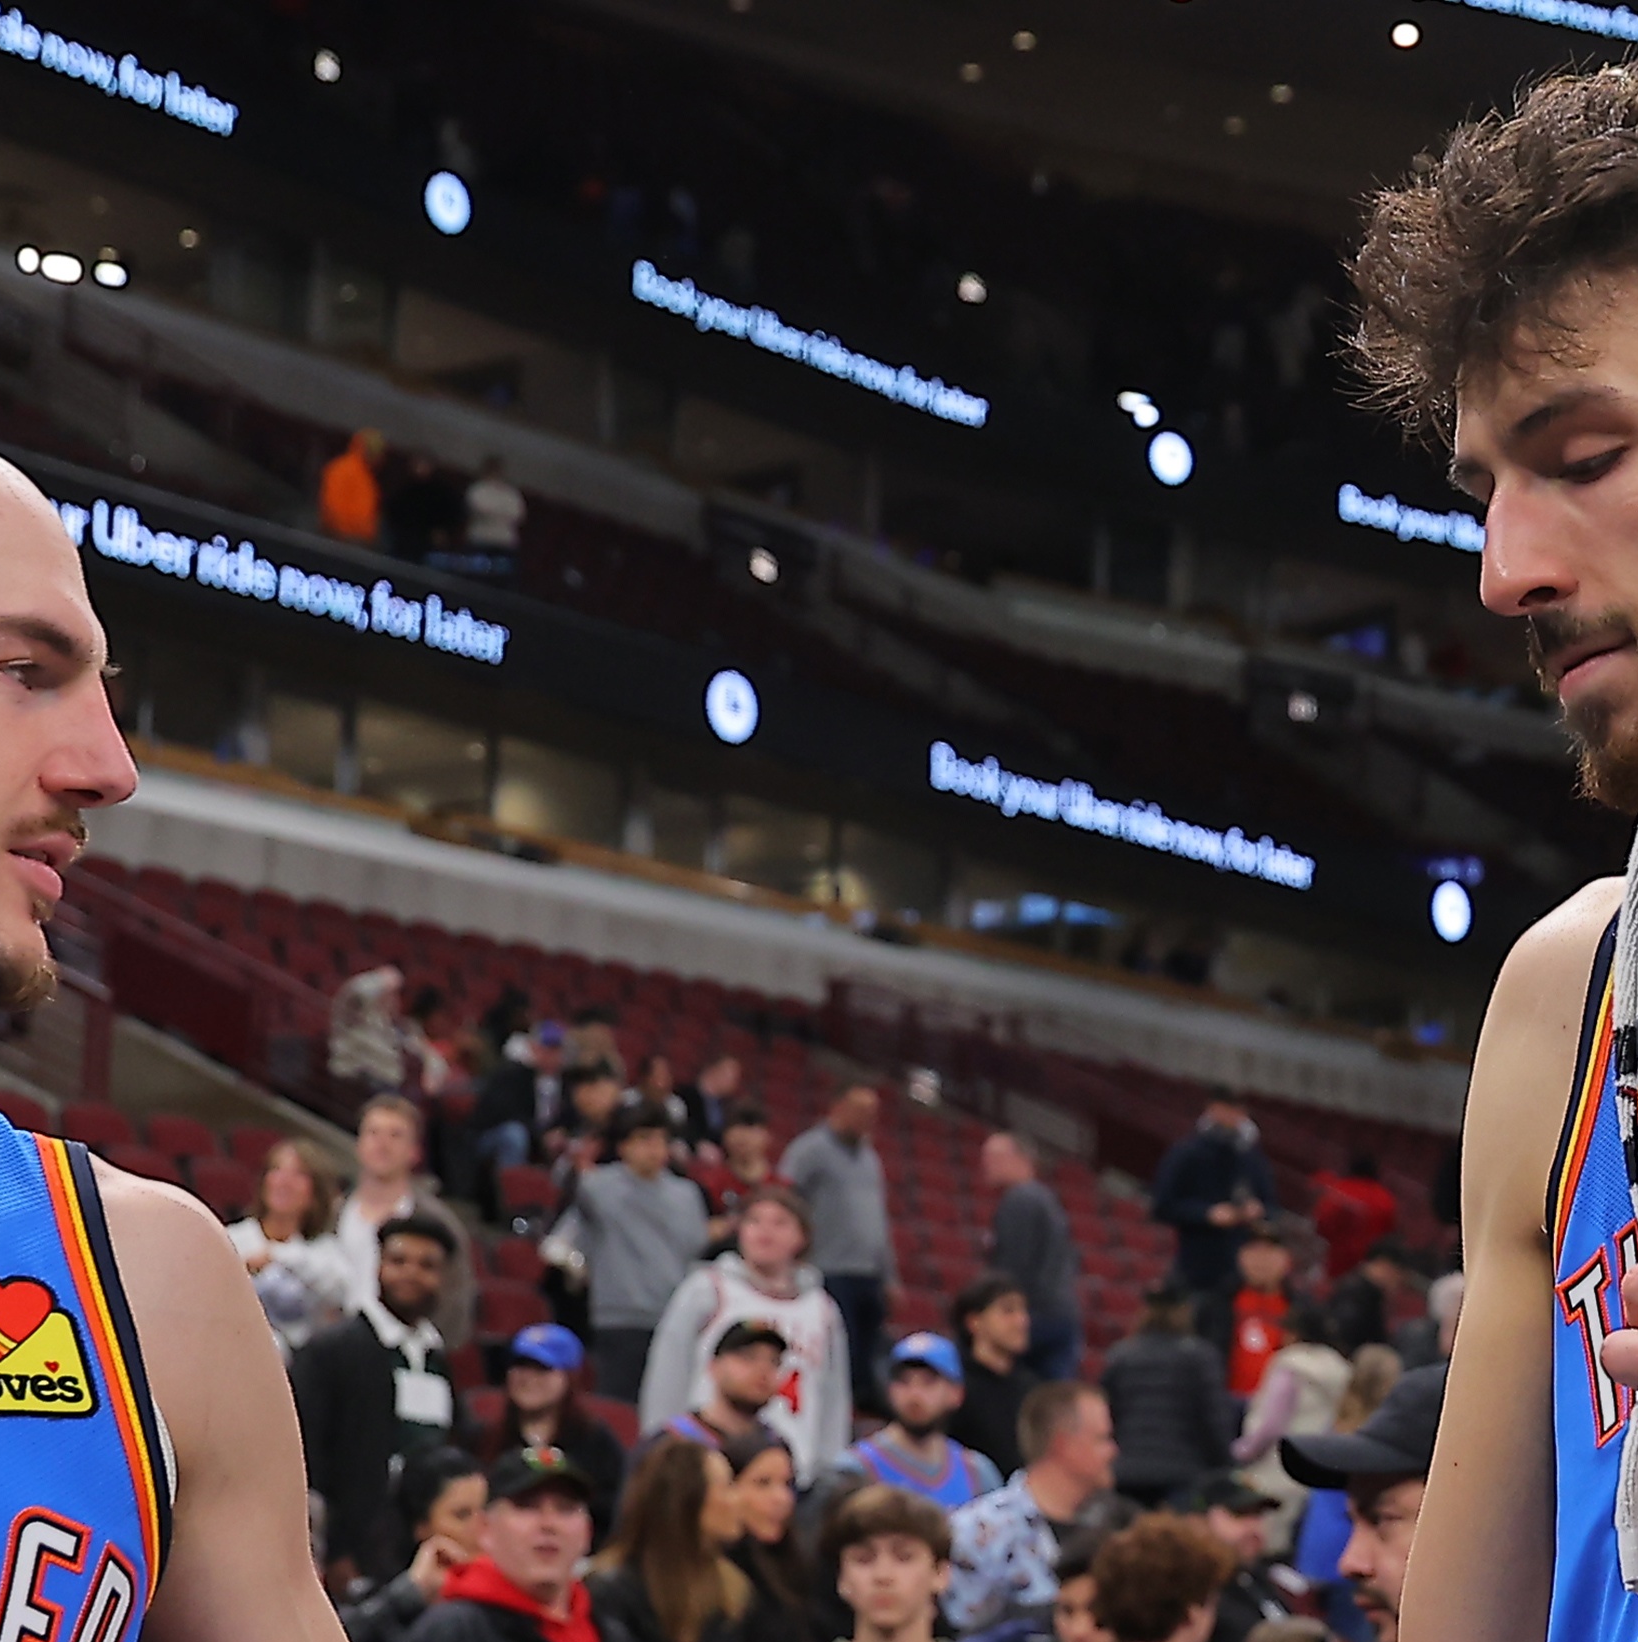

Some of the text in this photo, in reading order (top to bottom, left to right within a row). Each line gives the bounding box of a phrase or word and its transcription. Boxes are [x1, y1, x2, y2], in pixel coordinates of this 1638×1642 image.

[92, 500, 198, 578] Uber
[195, 535, 279, 599] ride
[278, 566, 368, 630] now,
[370, 580, 423, 641] for
[424, 595, 509, 663] later
